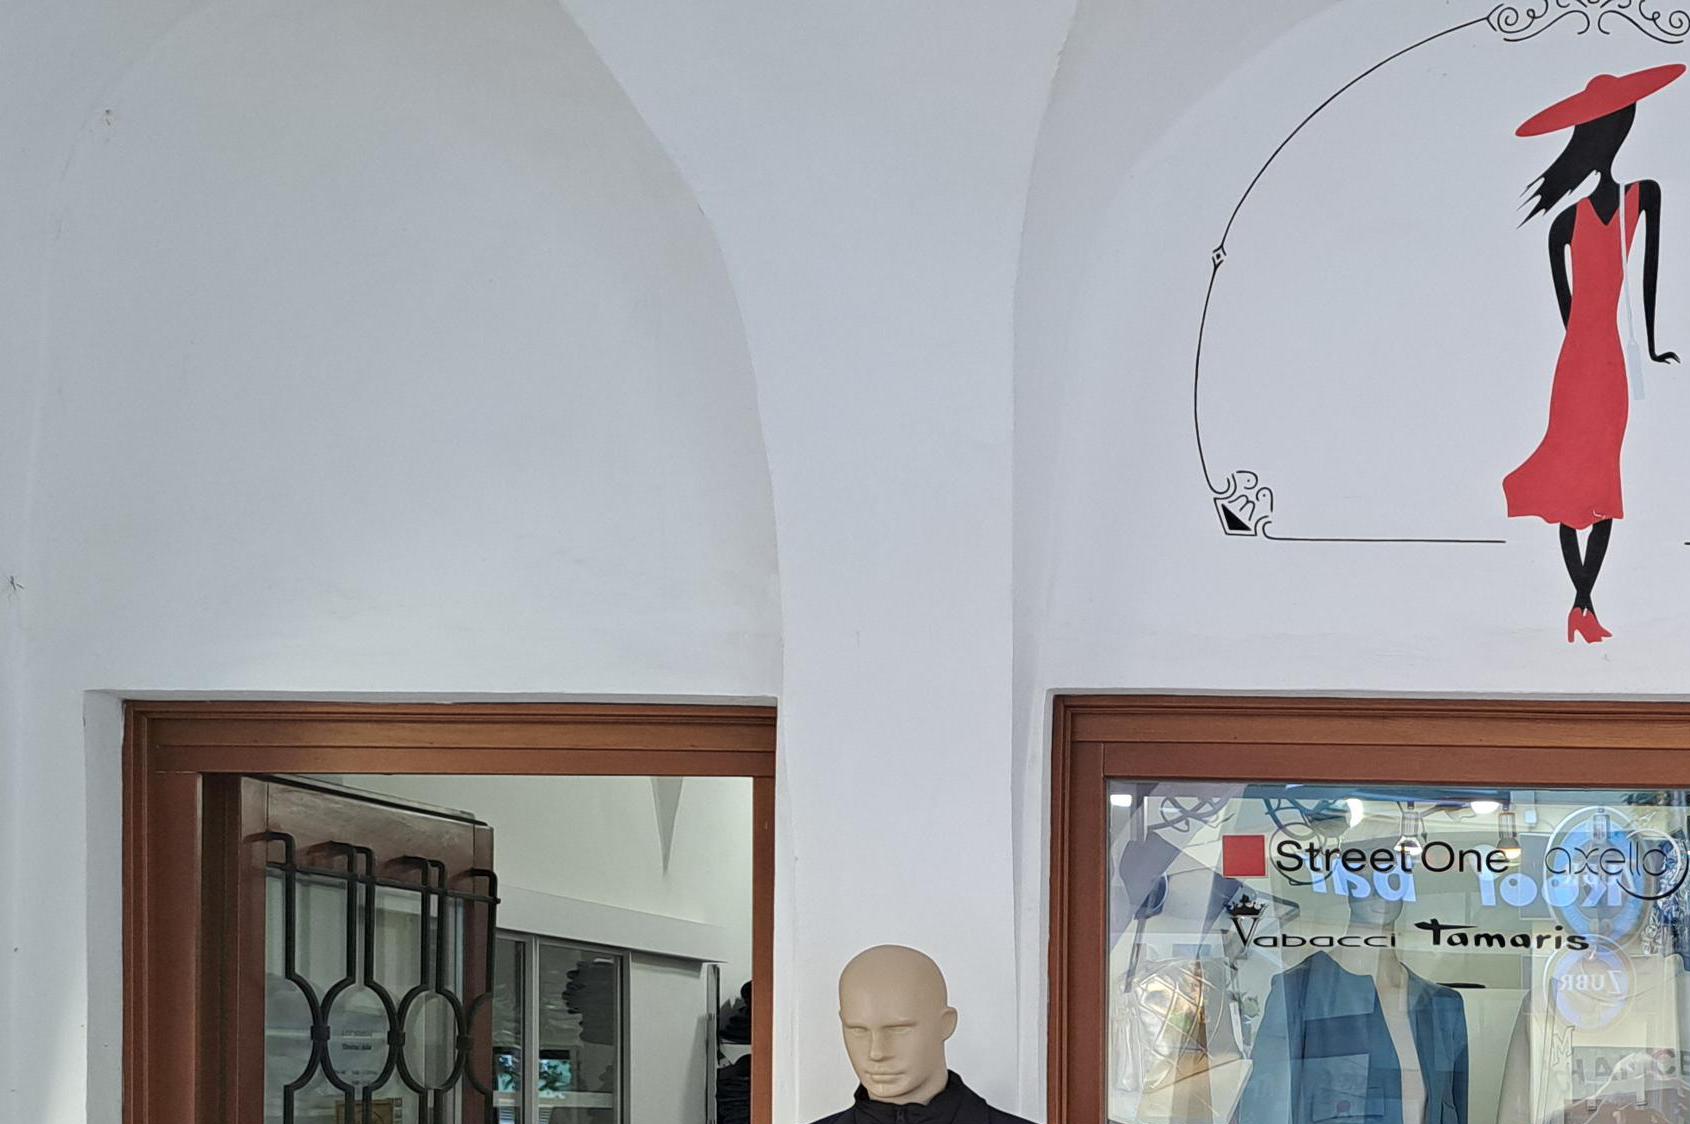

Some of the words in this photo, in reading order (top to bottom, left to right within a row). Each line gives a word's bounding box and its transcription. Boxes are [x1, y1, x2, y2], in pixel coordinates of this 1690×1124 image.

[1275, 840, 1414, 874] Street
[1421, 841, 1511, 874] One
[1230, 916, 1396, 949] Vabacci
[1413, 917, 1591, 952] Tamaris
